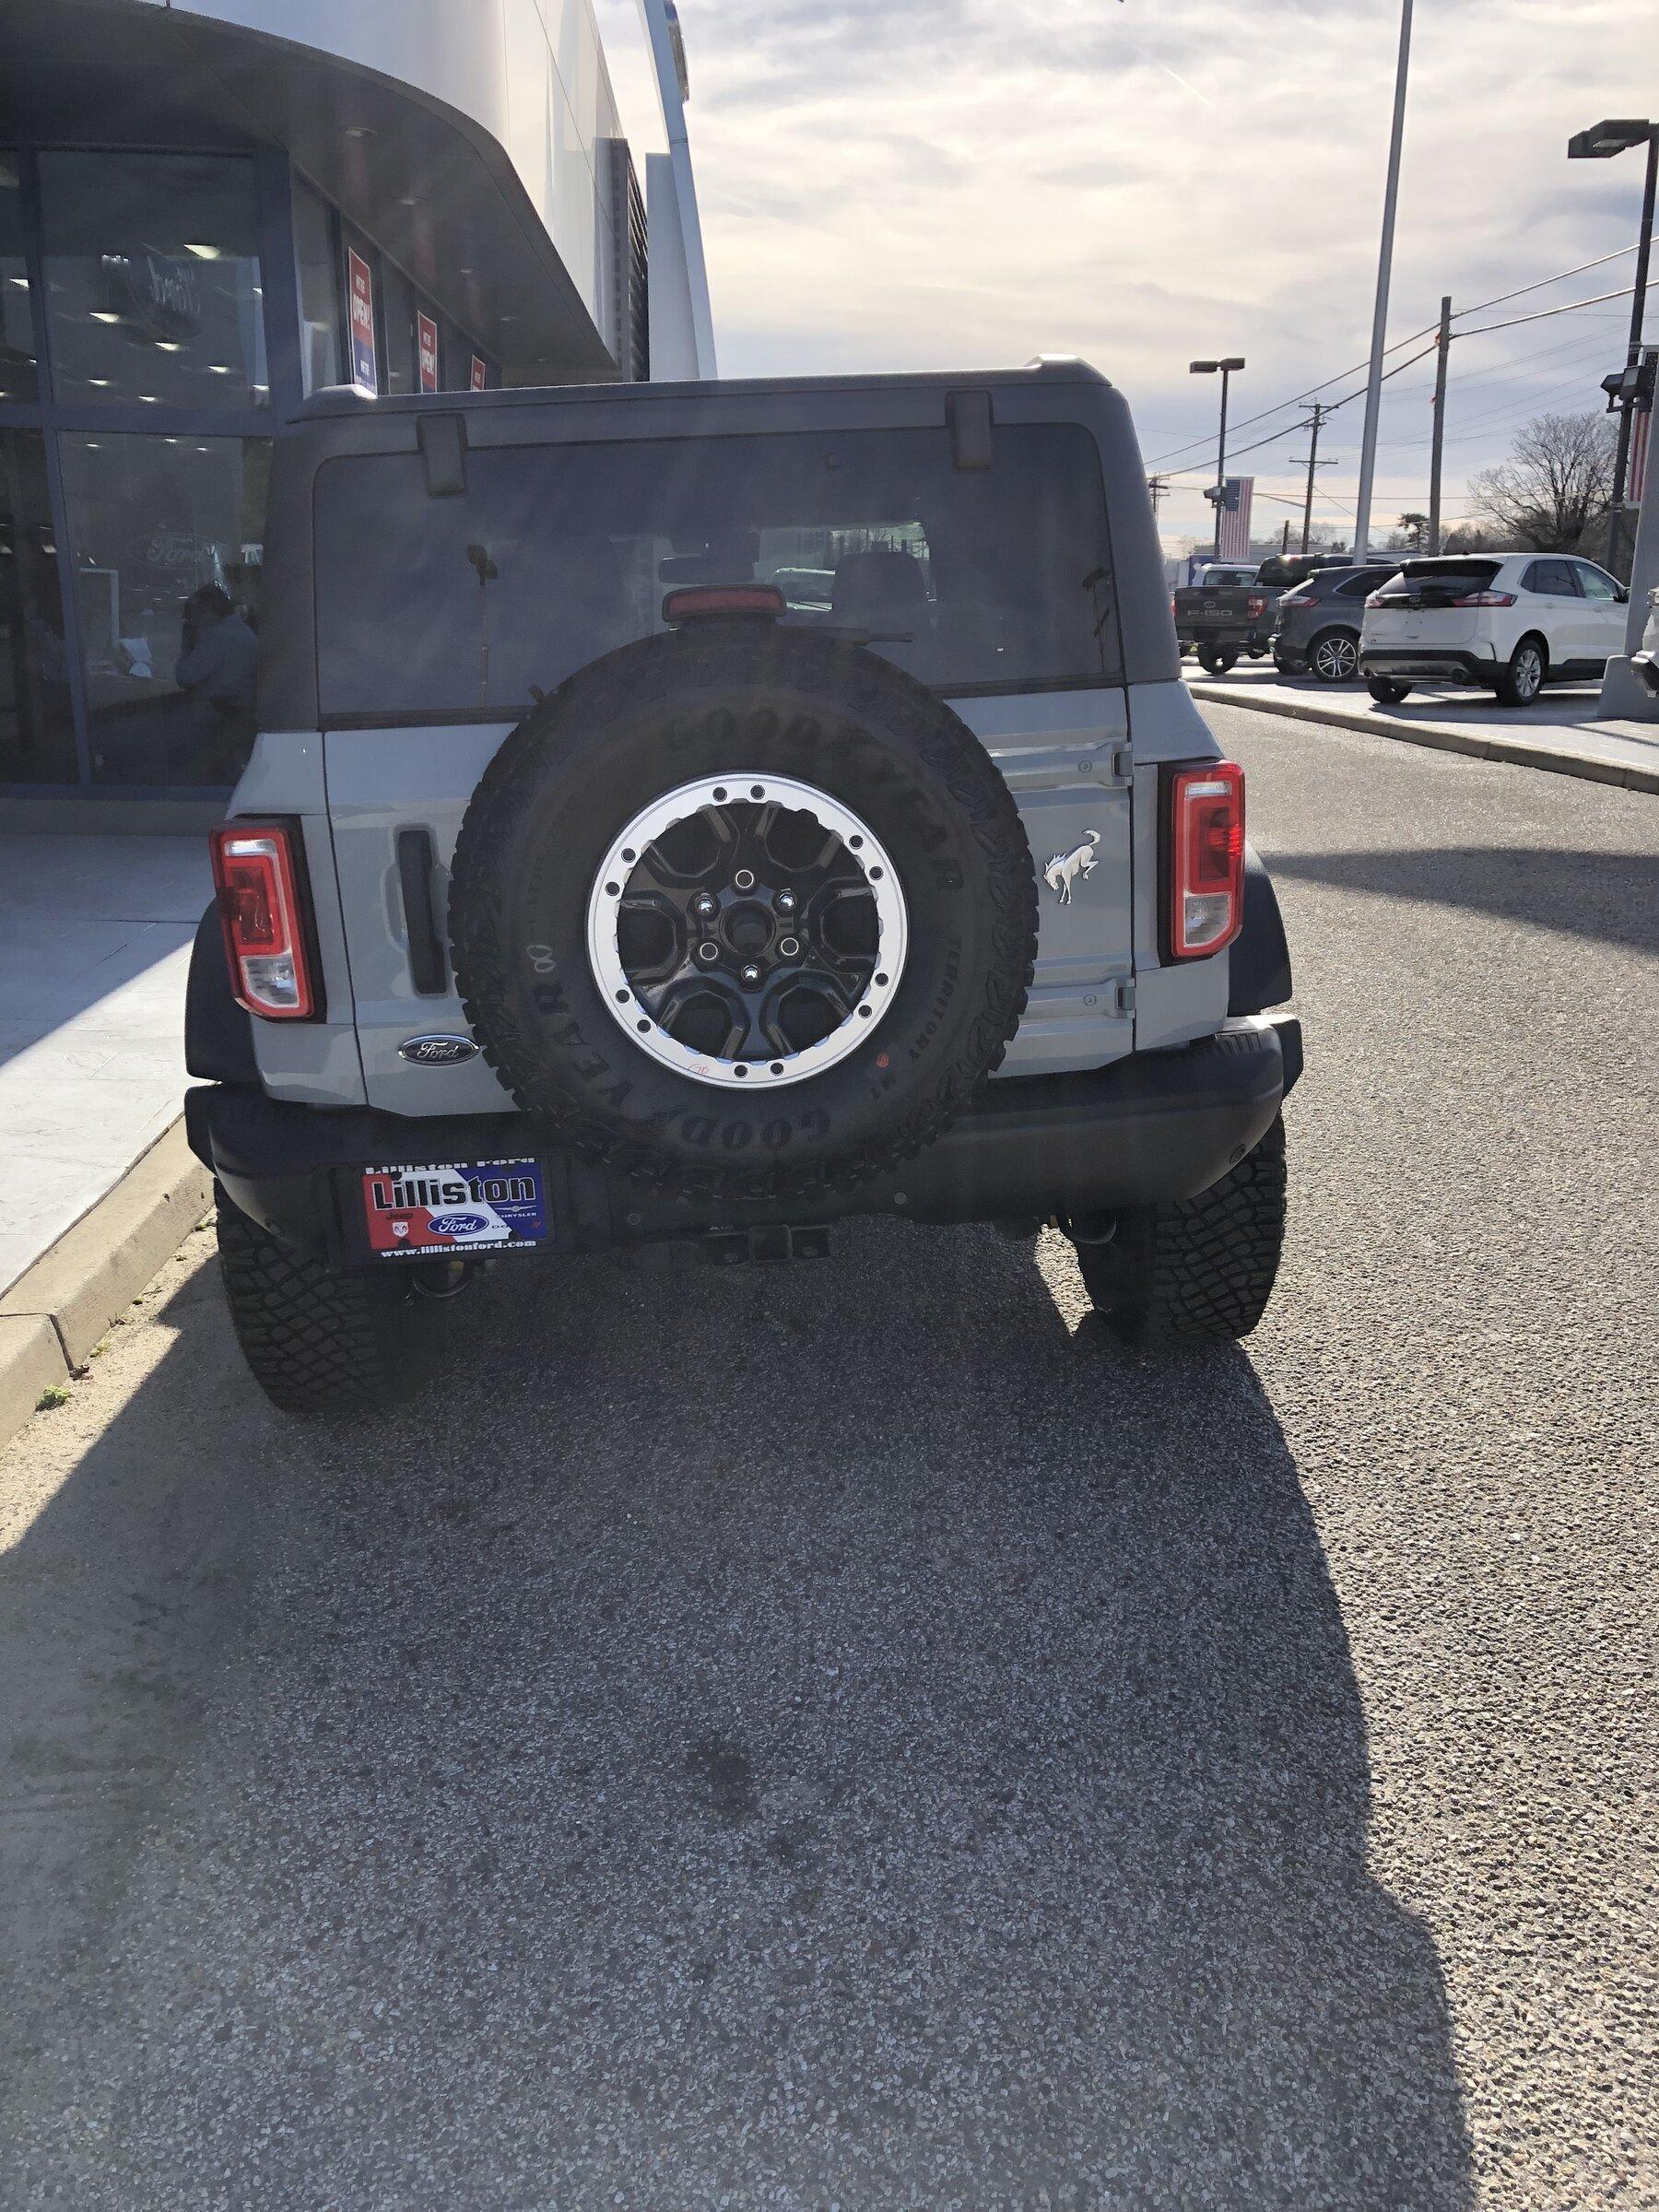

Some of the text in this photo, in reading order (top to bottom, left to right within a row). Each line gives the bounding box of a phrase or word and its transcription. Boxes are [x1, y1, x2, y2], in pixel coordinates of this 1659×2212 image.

[417, 1041, 460, 1059] Ford
[371, 1175, 536, 1211] Lilliston
[438, 1216, 477, 1233] Ford
[380, 1240, 537, 1258] www.lillistonford.com
